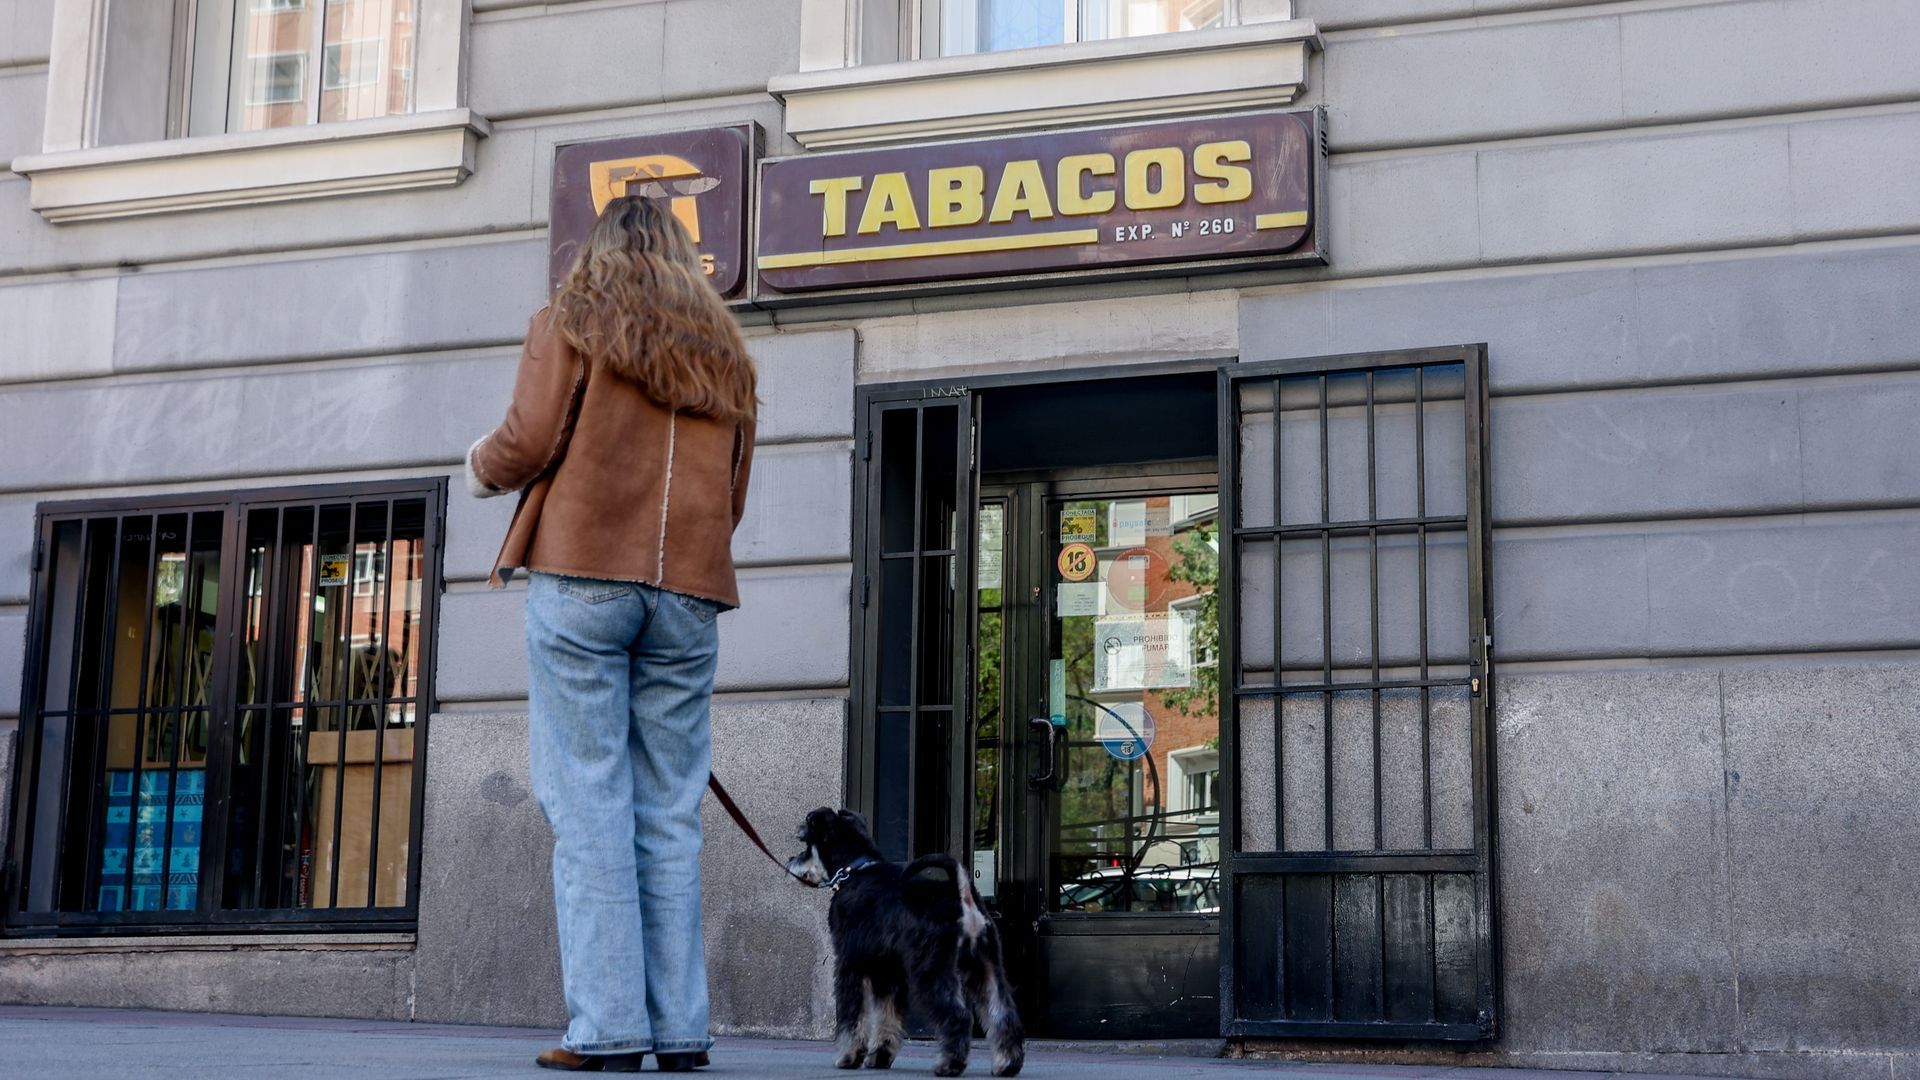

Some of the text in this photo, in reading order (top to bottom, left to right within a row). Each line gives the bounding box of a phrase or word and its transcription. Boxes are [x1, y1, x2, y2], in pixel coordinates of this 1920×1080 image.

[809, 139, 1253, 237] TABACOS
[1115, 224, 1156, 242] EXP.
[1200, 218, 1234, 235] 260
